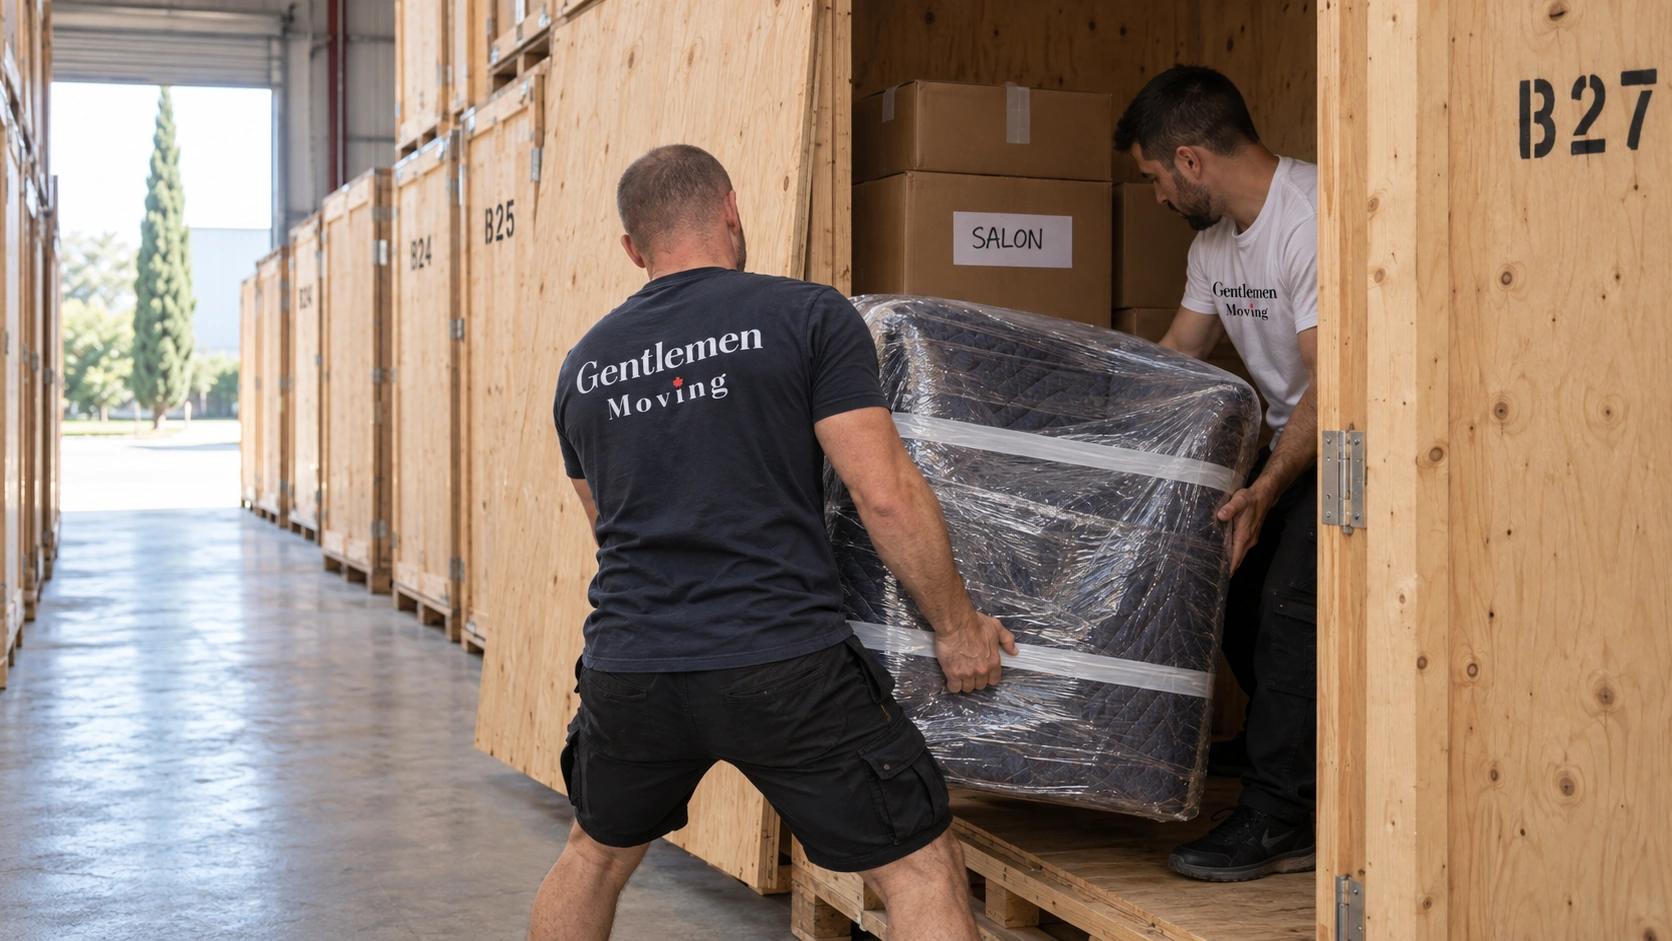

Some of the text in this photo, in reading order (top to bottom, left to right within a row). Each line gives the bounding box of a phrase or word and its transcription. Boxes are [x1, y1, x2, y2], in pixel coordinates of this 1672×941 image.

[1519, 68, 1657, 160] B27
[485, 199, 515, 245] B25
[971, 226, 1043, 249] SALON
[411, 234, 432, 271] B24
[1212, 281, 1278, 299] Gentlemen
[1226, 302, 1269, 321] Moving
[576, 328, 763, 395] Gentlemen
[606, 373, 729, 421] Moving
